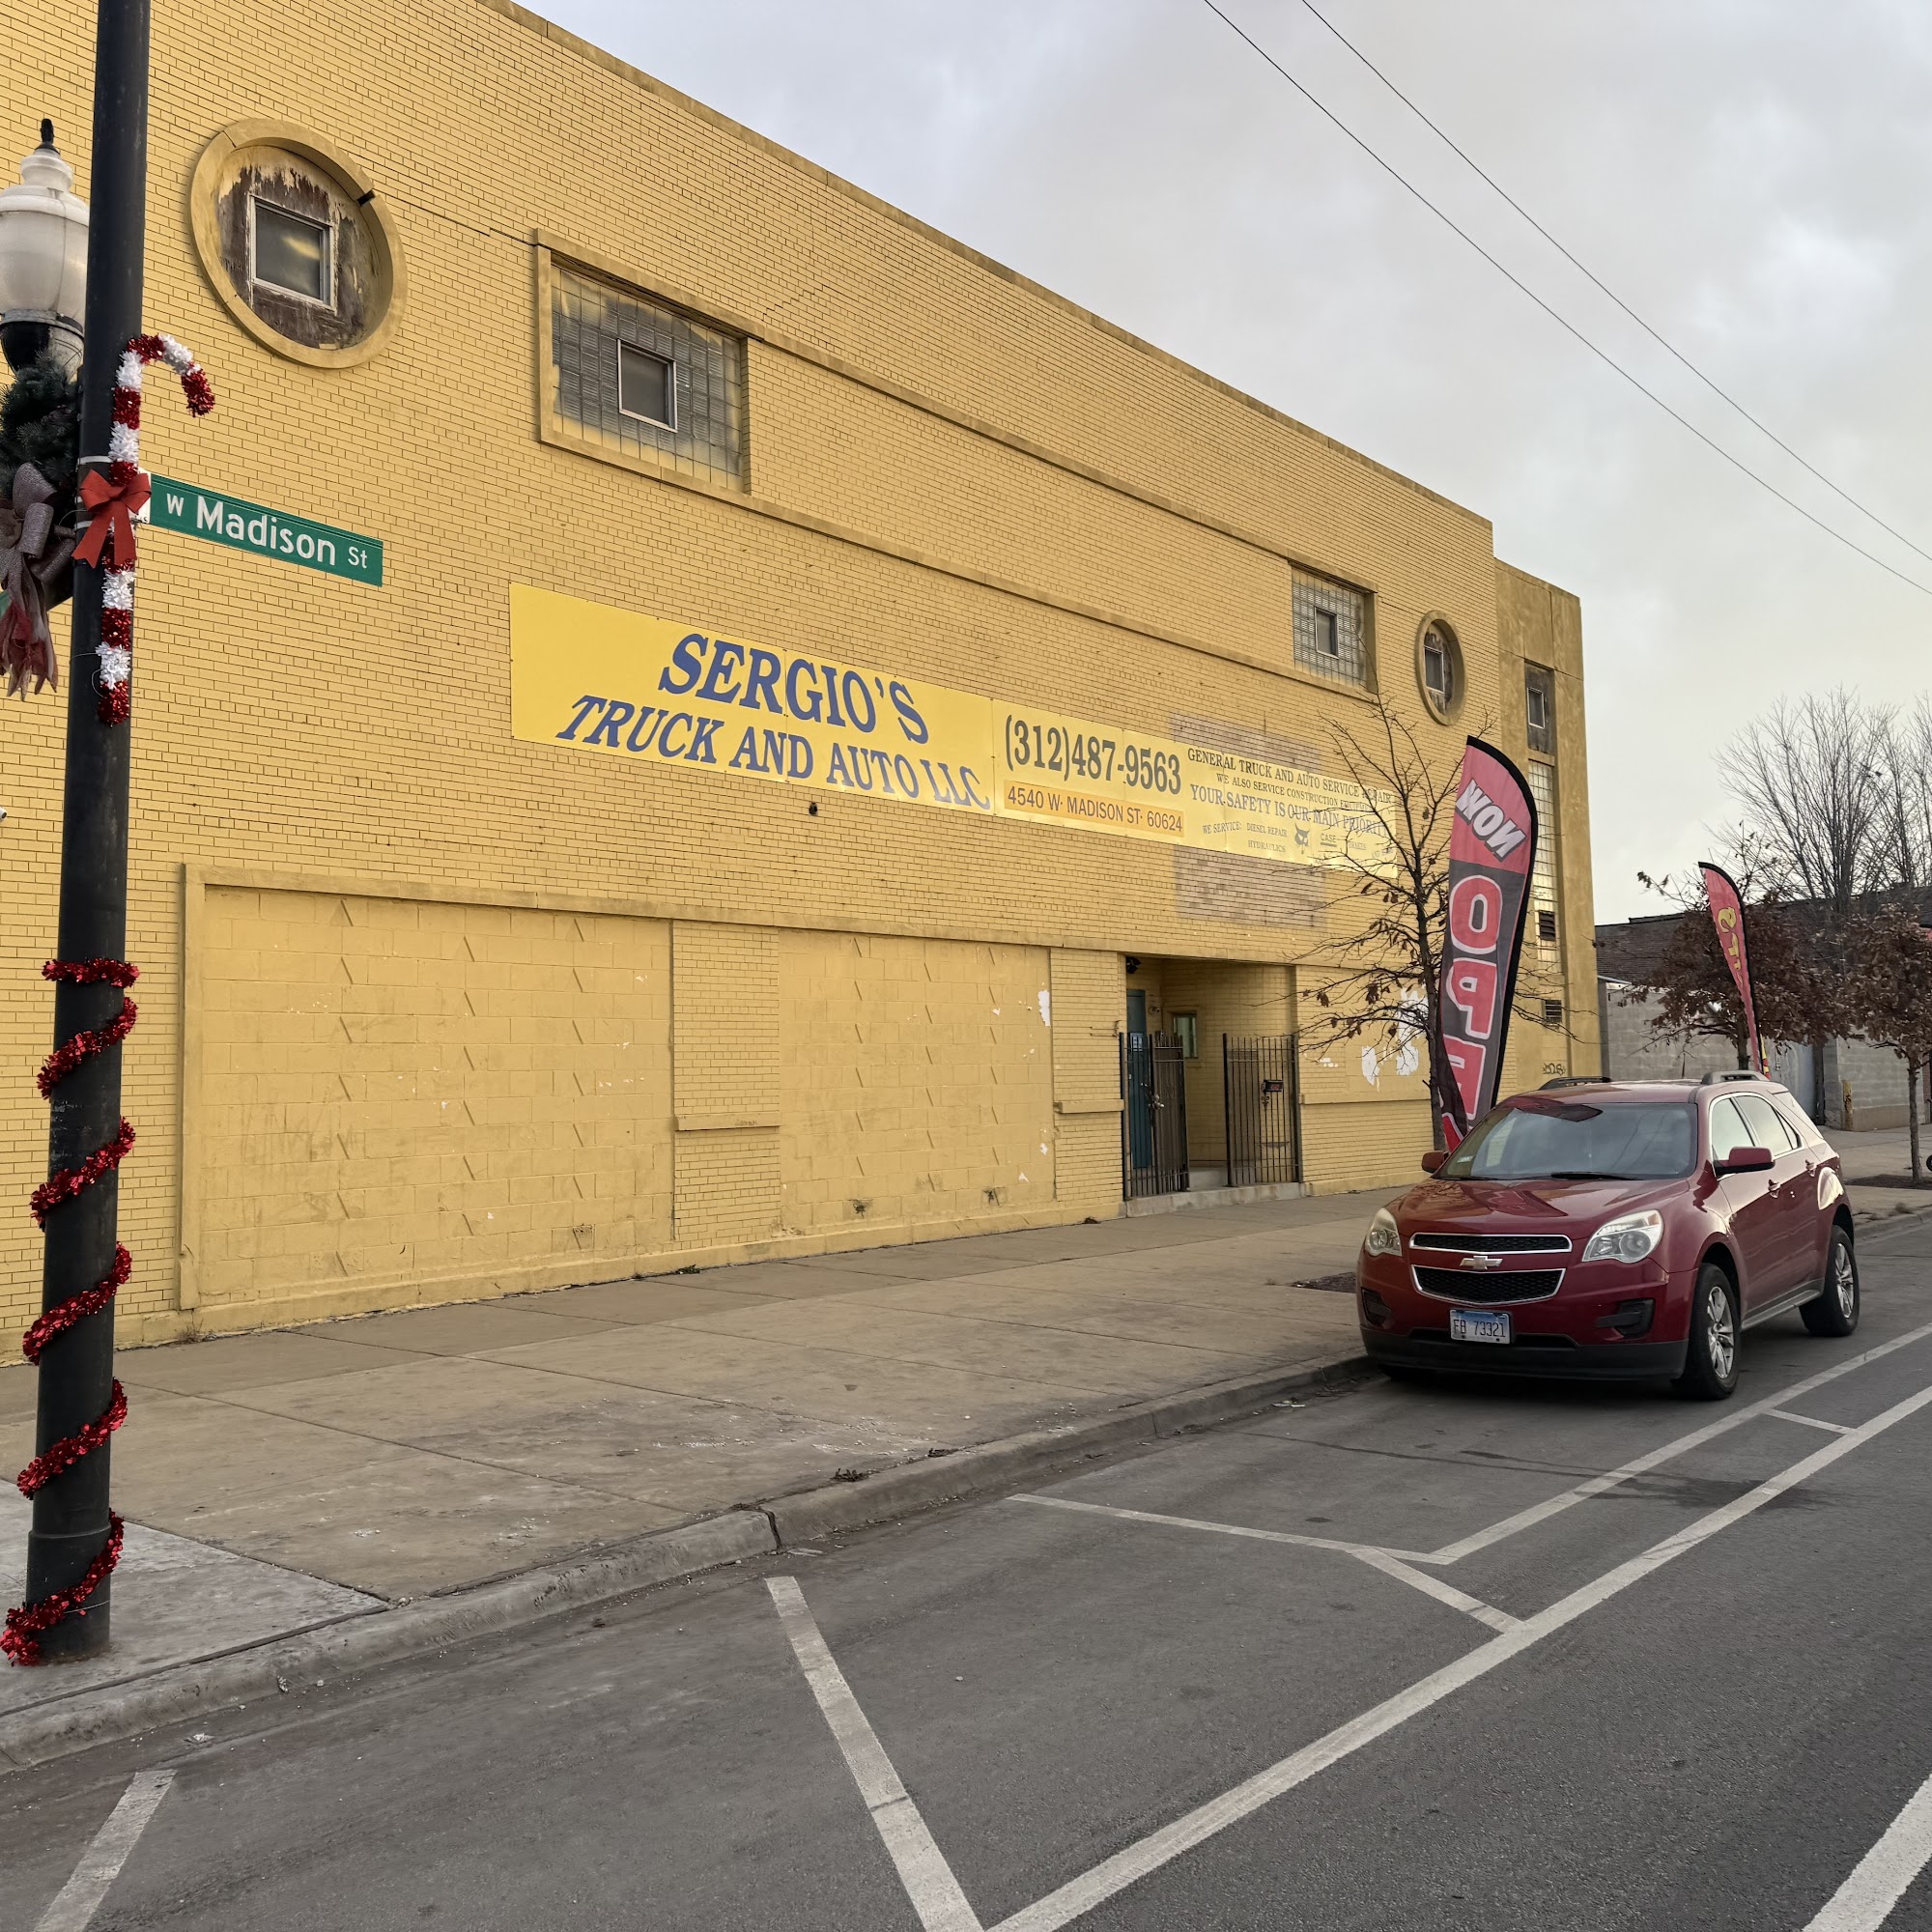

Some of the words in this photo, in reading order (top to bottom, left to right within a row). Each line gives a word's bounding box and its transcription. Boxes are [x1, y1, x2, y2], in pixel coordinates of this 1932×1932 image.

[166, 493, 185, 517] W
[196, 495, 336, 566] Madison
[347, 546, 368, 569] St
[658, 633, 929, 745] SERGIO'S
[555, 695, 725, 763] TRUCK
[729, 725, 814, 780] AND
[826, 748, 920, 799] AUTO
[920, 759, 991, 810] LLC
[1006, 714, 1181, 795] (312)487-9563
[1187, 748, 1236, 770] GENERAL
[1238, 759, 1272, 779] TRUCK
[1275, 768, 1294, 783] AND
[1296, 773, 1320, 789] AUTO
[1322, 778, 1359, 798] SERVICE
[1008, 785, 1044, 809] 4540
[1066, 796, 1123, 822] MADISON
[1147, 810, 1182, 832] 60624
[1190, 783, 1224, 806] YOUR
[1227, 791, 1271, 814] SAFETY
[1274, 801, 1286, 817] IS
[1288, 803, 1309, 822] OUR
[1313, 808, 1339, 828] MAIN
[1216, 773, 1229, 784] WE
[1232, 777, 1251, 789] ALSO
[1253, 781, 1285, 796] SERVICE
[1287, 787, 1338, 807] CONSTRUCTION
[1321, 833, 1337, 843] CASE
[1472, 1321, 1506, 1338] 73321
